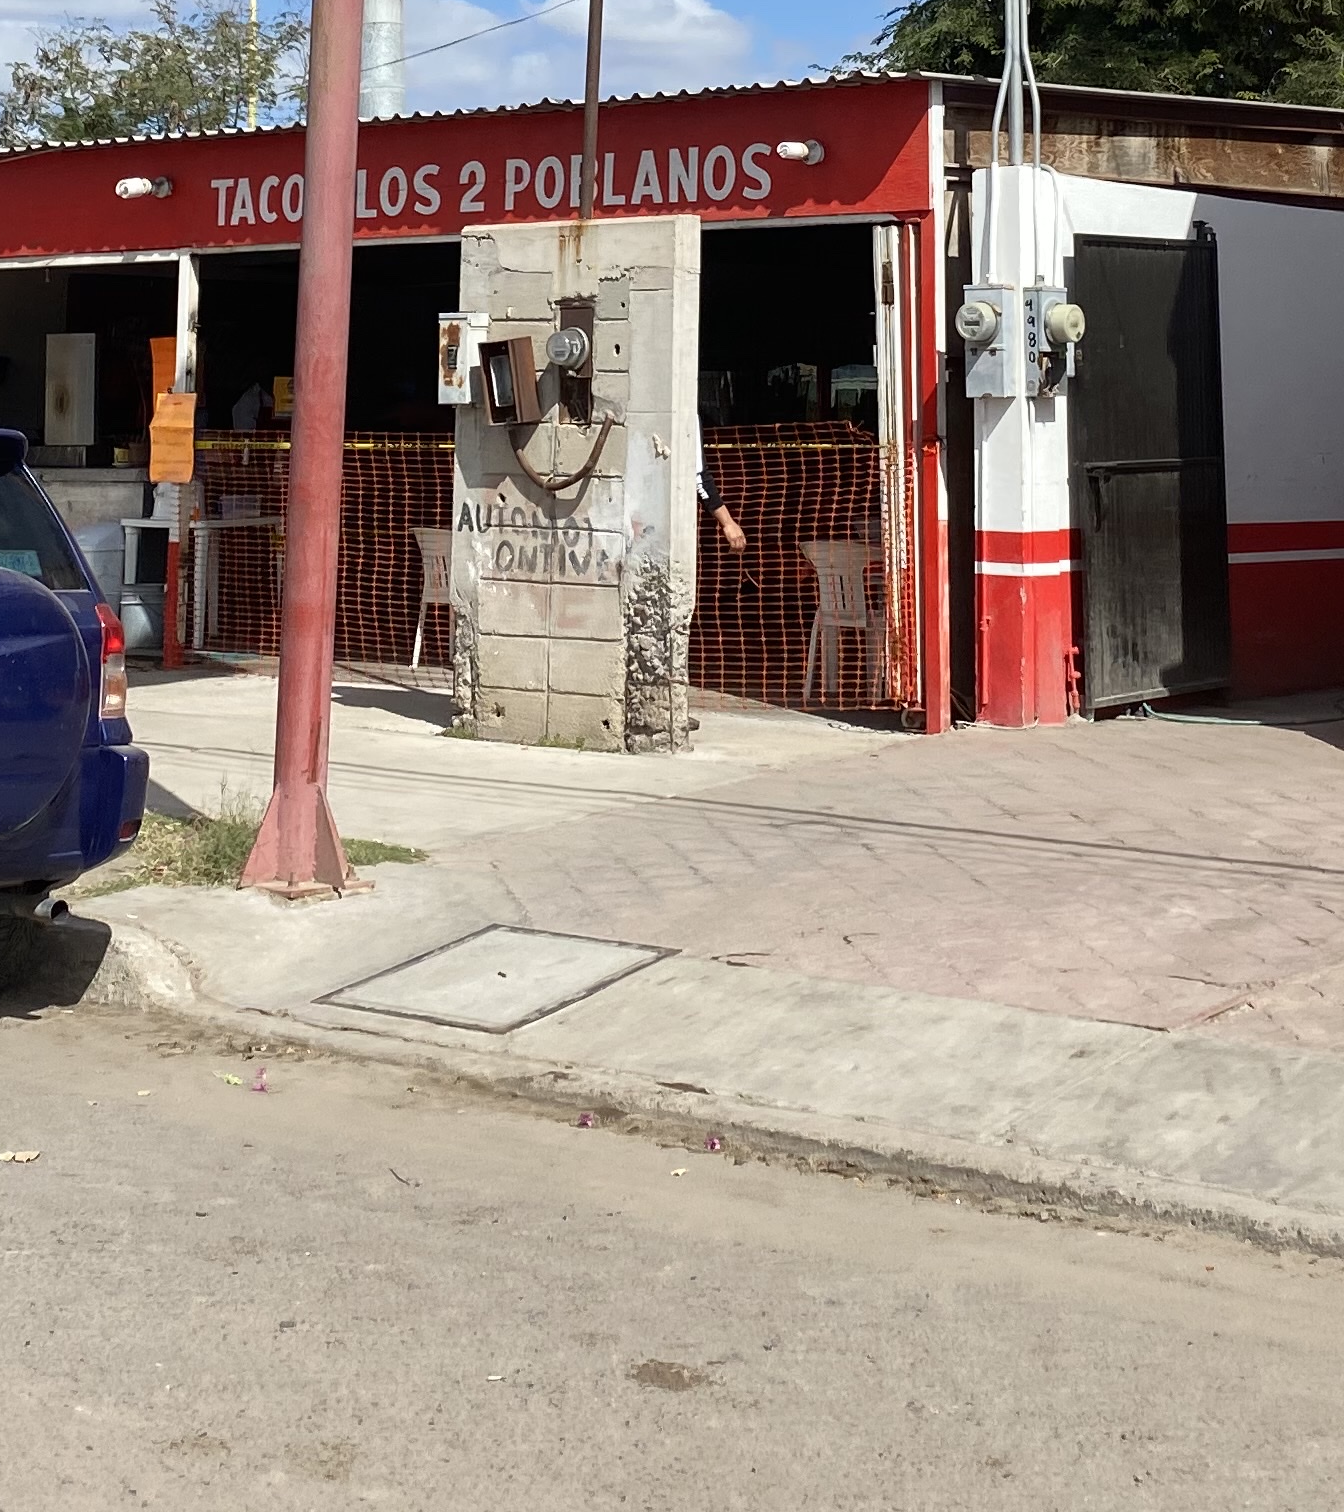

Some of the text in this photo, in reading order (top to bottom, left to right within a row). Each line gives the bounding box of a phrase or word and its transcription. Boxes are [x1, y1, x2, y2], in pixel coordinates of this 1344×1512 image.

[210, 173, 305, 227] TACO
[356, 163, 441, 217] LOS
[458, 160, 486, 213] 2
